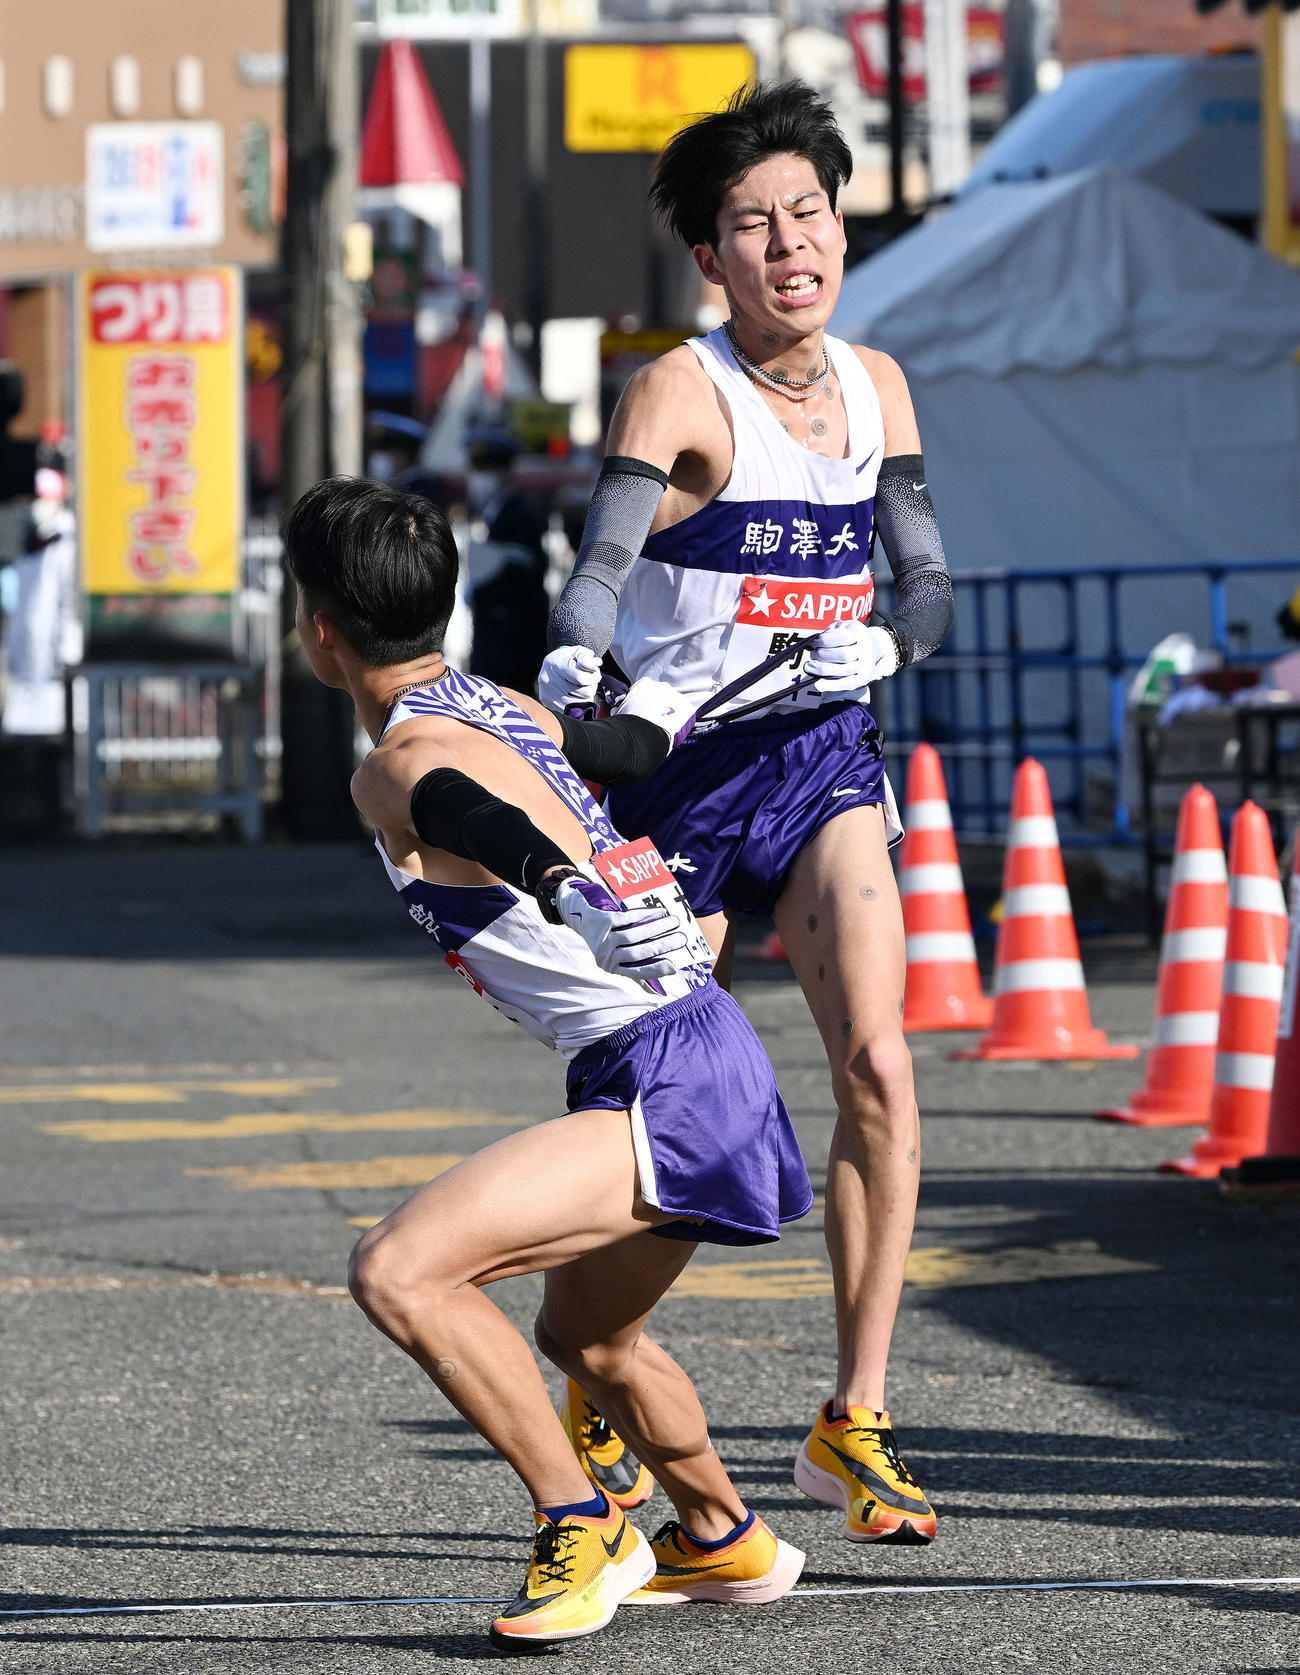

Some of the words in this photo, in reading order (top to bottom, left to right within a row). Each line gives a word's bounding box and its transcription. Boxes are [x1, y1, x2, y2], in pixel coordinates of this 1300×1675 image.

[740, 515, 874, 560] 駒澤大
[621, 849, 672, 884] SAPP
